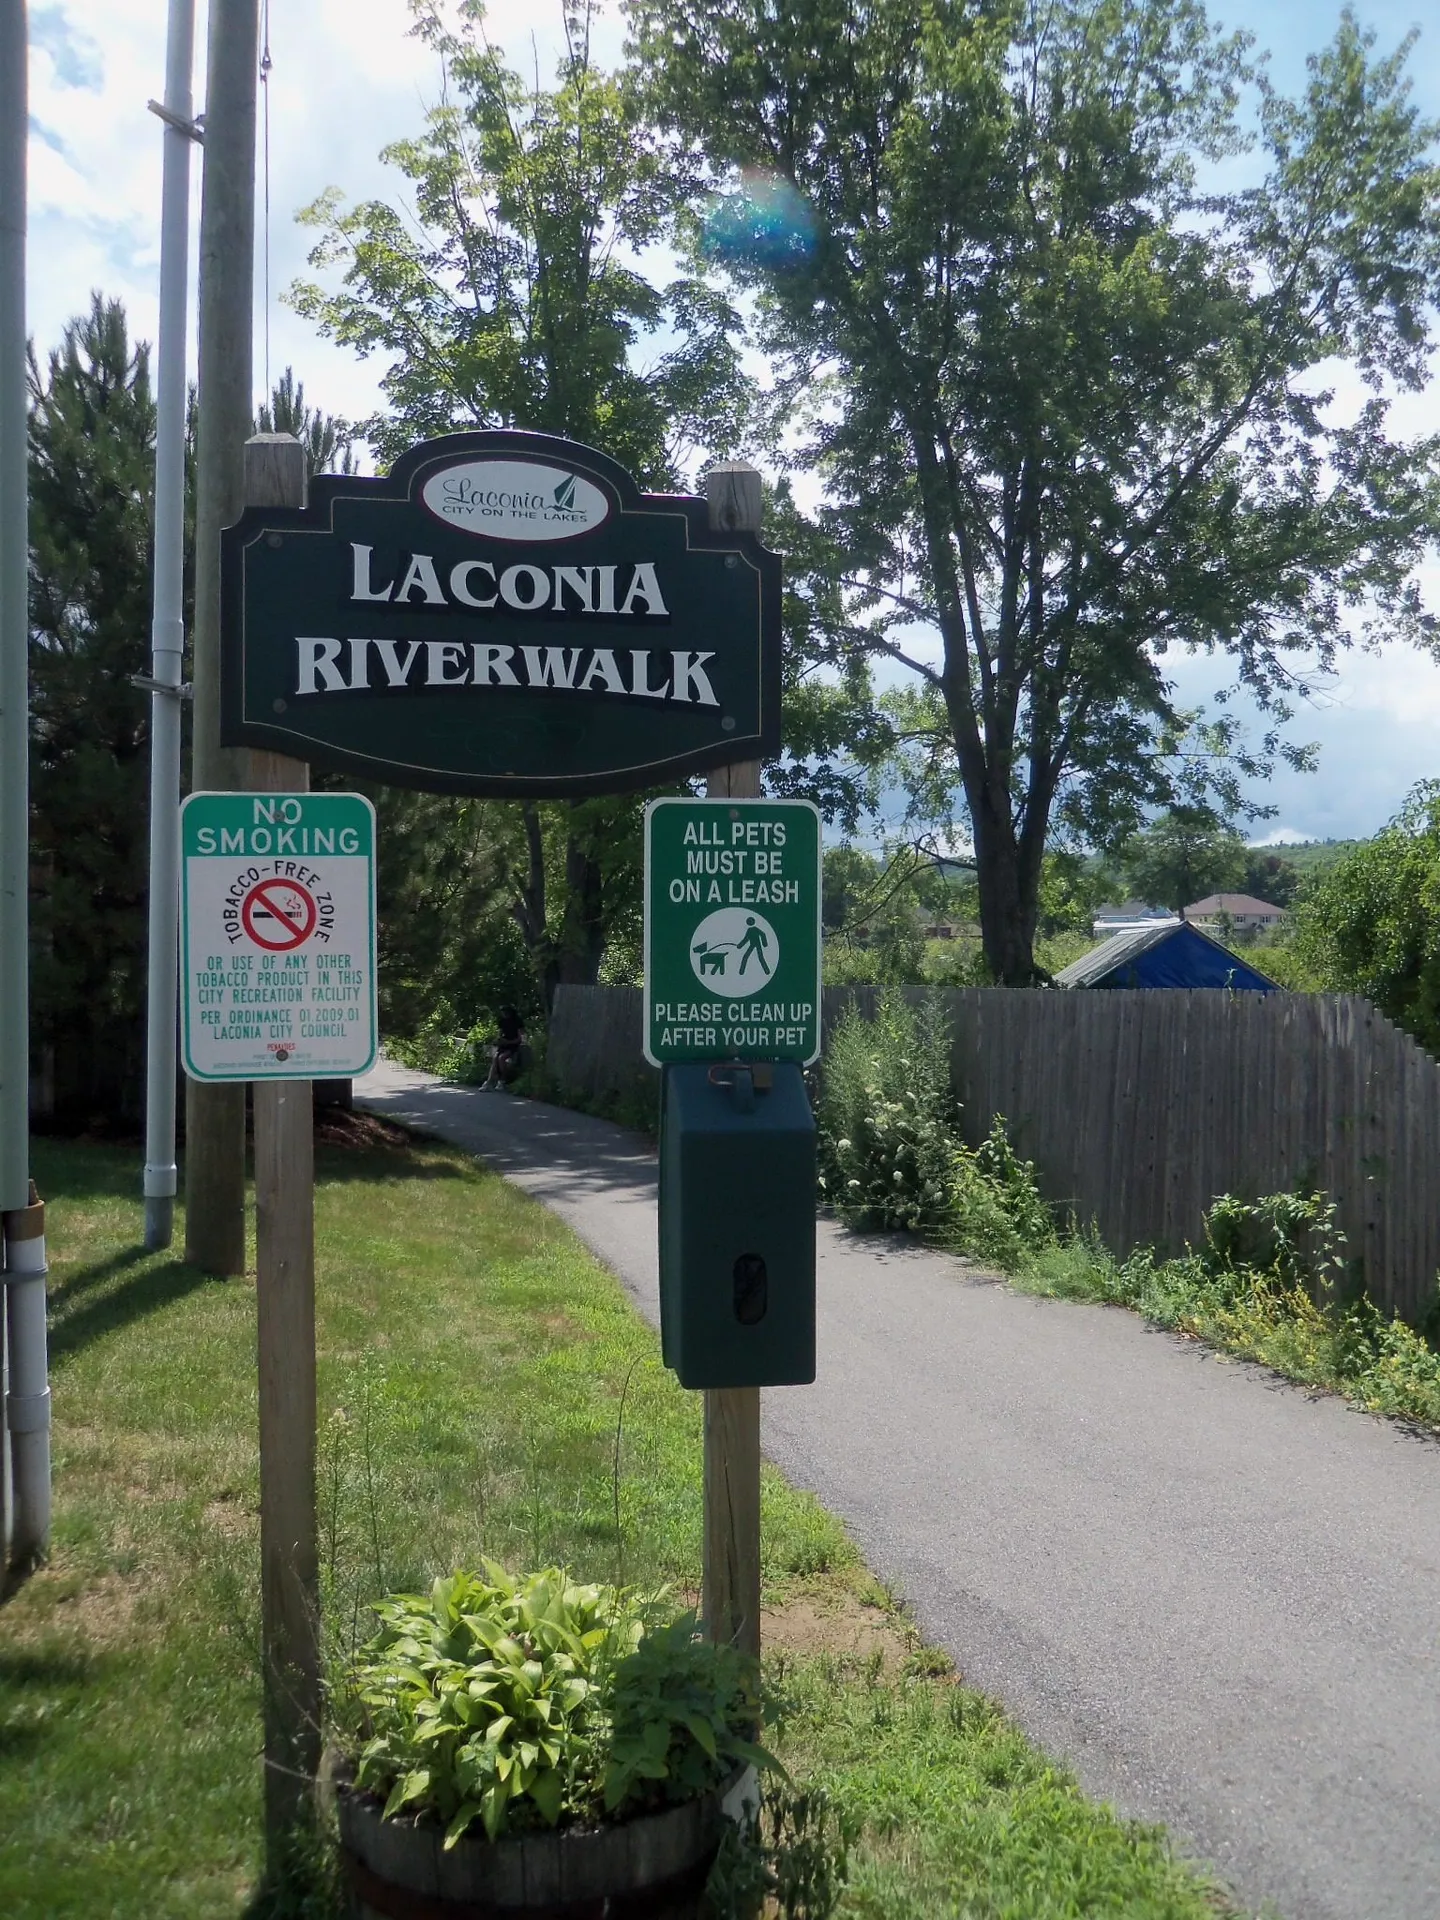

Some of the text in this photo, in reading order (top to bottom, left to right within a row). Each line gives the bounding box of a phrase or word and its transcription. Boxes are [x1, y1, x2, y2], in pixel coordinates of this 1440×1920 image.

[442, 478, 549, 509] Laconia
[442, 505, 588, 523] CITY ON THE LAKES
[350, 542, 670, 616] LACONIA
[294, 637, 721, 707] RIVERWALK
[253, 799, 302, 825] NO
[197, 827, 359, 854] SMOKING
[683, 822, 786, 846] ALL PETS
[687, 851, 783, 875] MUST BE
[223, 860, 335, 944] TOBACCO-FREE ZONE
[669, 879, 799, 904] ON A LEASH
[207, 955, 351, 970] OR USE OF ANY OTHER
[196, 971, 362, 987] TOBACCO PRODUCT IN THIS
[199, 987, 361, 1003] CITY RECREATION FACILITY
[201, 1008, 359, 1024] PER ORDINANCE 01.2009.01
[655, 1003, 812, 1022] PLEASE CLEAN UP
[214, 1023, 347, 1040] LACONIA CITY COUNCIL
[660, 1027, 807, 1046] AFTER YOUR PET
